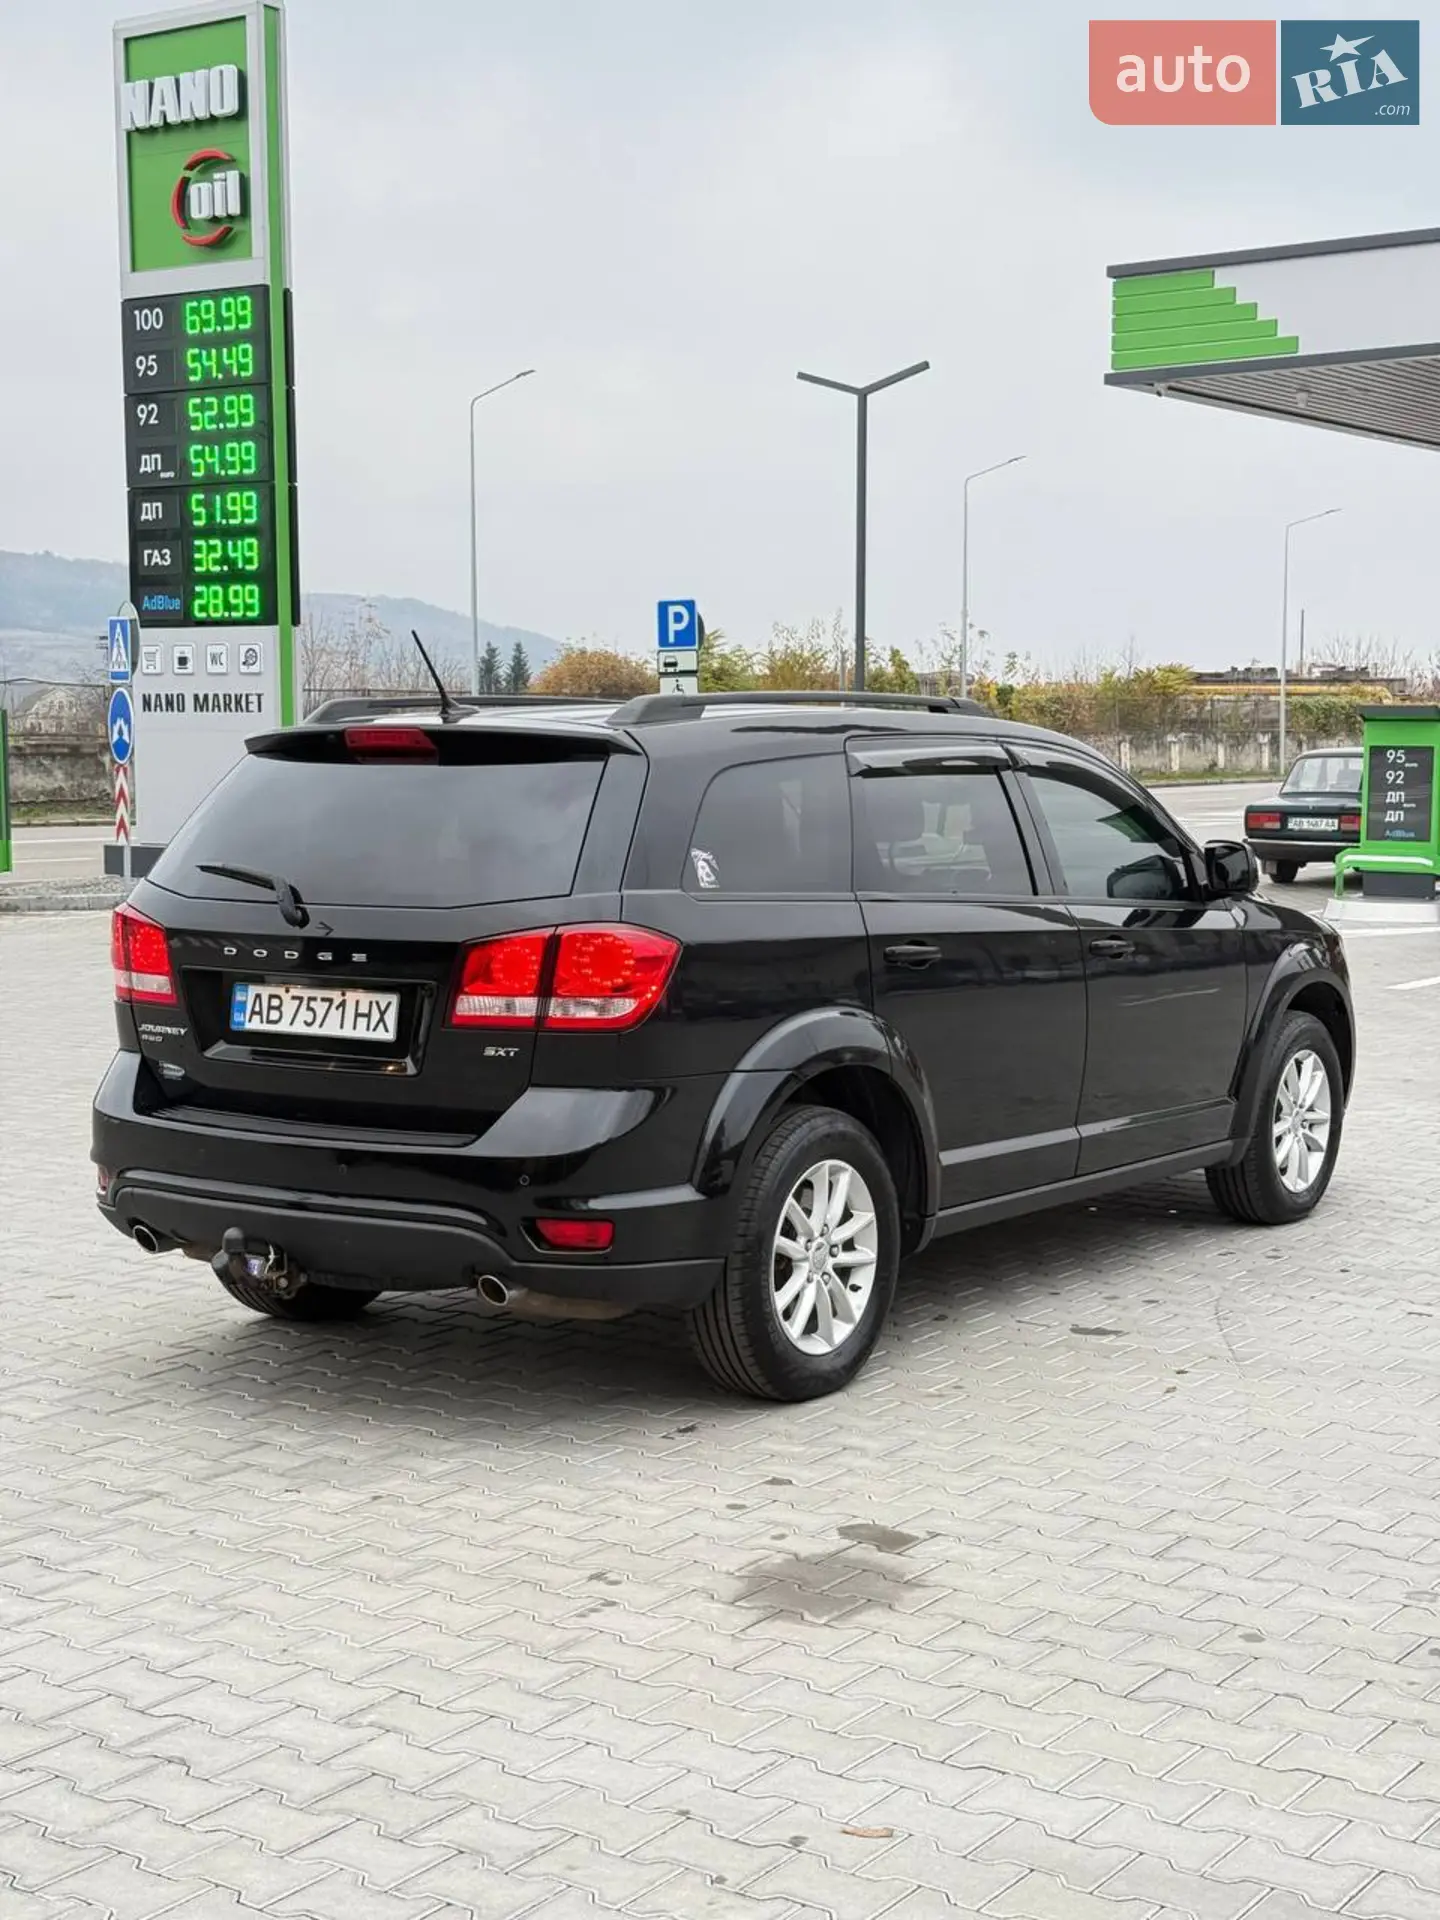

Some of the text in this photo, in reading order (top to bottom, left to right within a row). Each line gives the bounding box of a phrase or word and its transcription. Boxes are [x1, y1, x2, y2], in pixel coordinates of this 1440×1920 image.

[121, 63, 240, 131] NANO
[190, 169, 242, 219] oil
[133, 308, 164, 331] 100
[185, 295, 252, 335] 69.99
[135, 355, 158, 378] 95
[186, 343, 254, 382] 54.49
[137, 403, 159, 426] 92
[188, 394, 255, 432] 52.99
[139, 453, 162, 474] ДП
[189, 440, 257, 477] 54.99
[140, 502, 163, 522] ДП
[191, 491, 258, 527] 51.99
[143, 549, 172, 567] ГАЗ
[193, 538, 259, 573] 32.49
[142, 595, 181, 611] AdBlue
[193, 584, 260, 619] 28.99
[667, 604, 690, 644] P
[209, 651, 225, 667] WC
[142, 692, 264, 713] NANO MARKET
[1386, 749, 1406, 764] 95
[1385, 770, 1405, 784] 92
[1385, 791, 1405, 804] ДП
[1384, 810, 1405, 823] ДП
[223, 947, 368, 962] DODGE
[248, 993, 283, 1025] AB
[289, 995, 347, 1029] 7571
[353, 999, 392, 1033] HX
[483, 1046, 520, 1057] SXT
